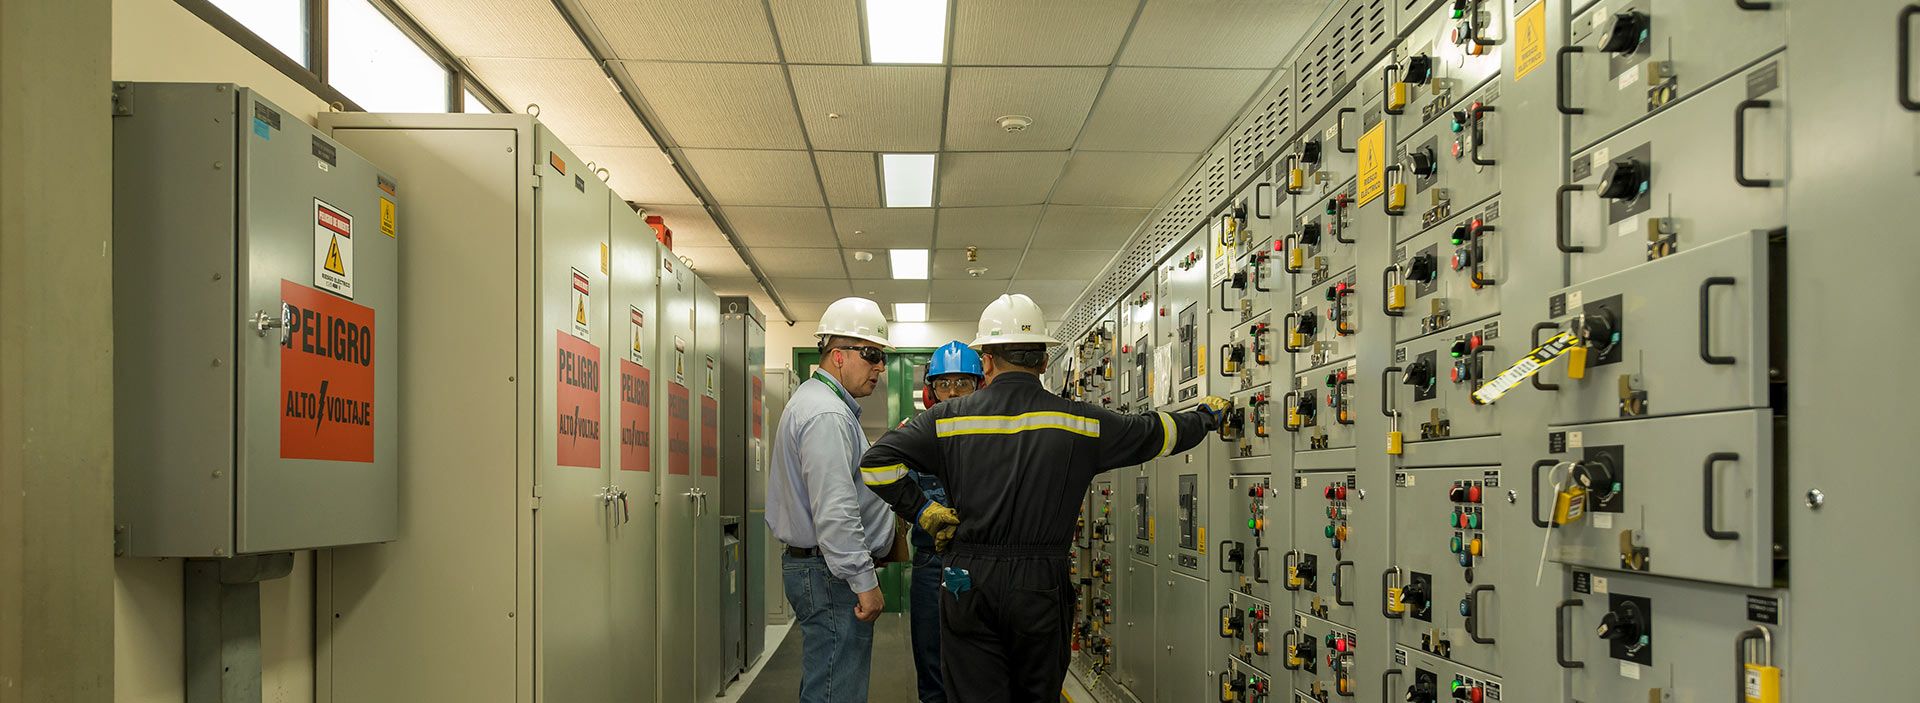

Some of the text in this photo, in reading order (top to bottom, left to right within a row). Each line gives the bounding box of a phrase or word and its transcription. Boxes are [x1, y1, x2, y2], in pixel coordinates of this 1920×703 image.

[286, 304, 371, 367] PELIGRO
[559, 348, 599, 393] PELIGRO
[286, 390, 370, 426] ALTO VOLTAJE
[622, 373, 649, 408] PELIGRO
[559, 414, 599, 440] ALTO VOLTAJE
